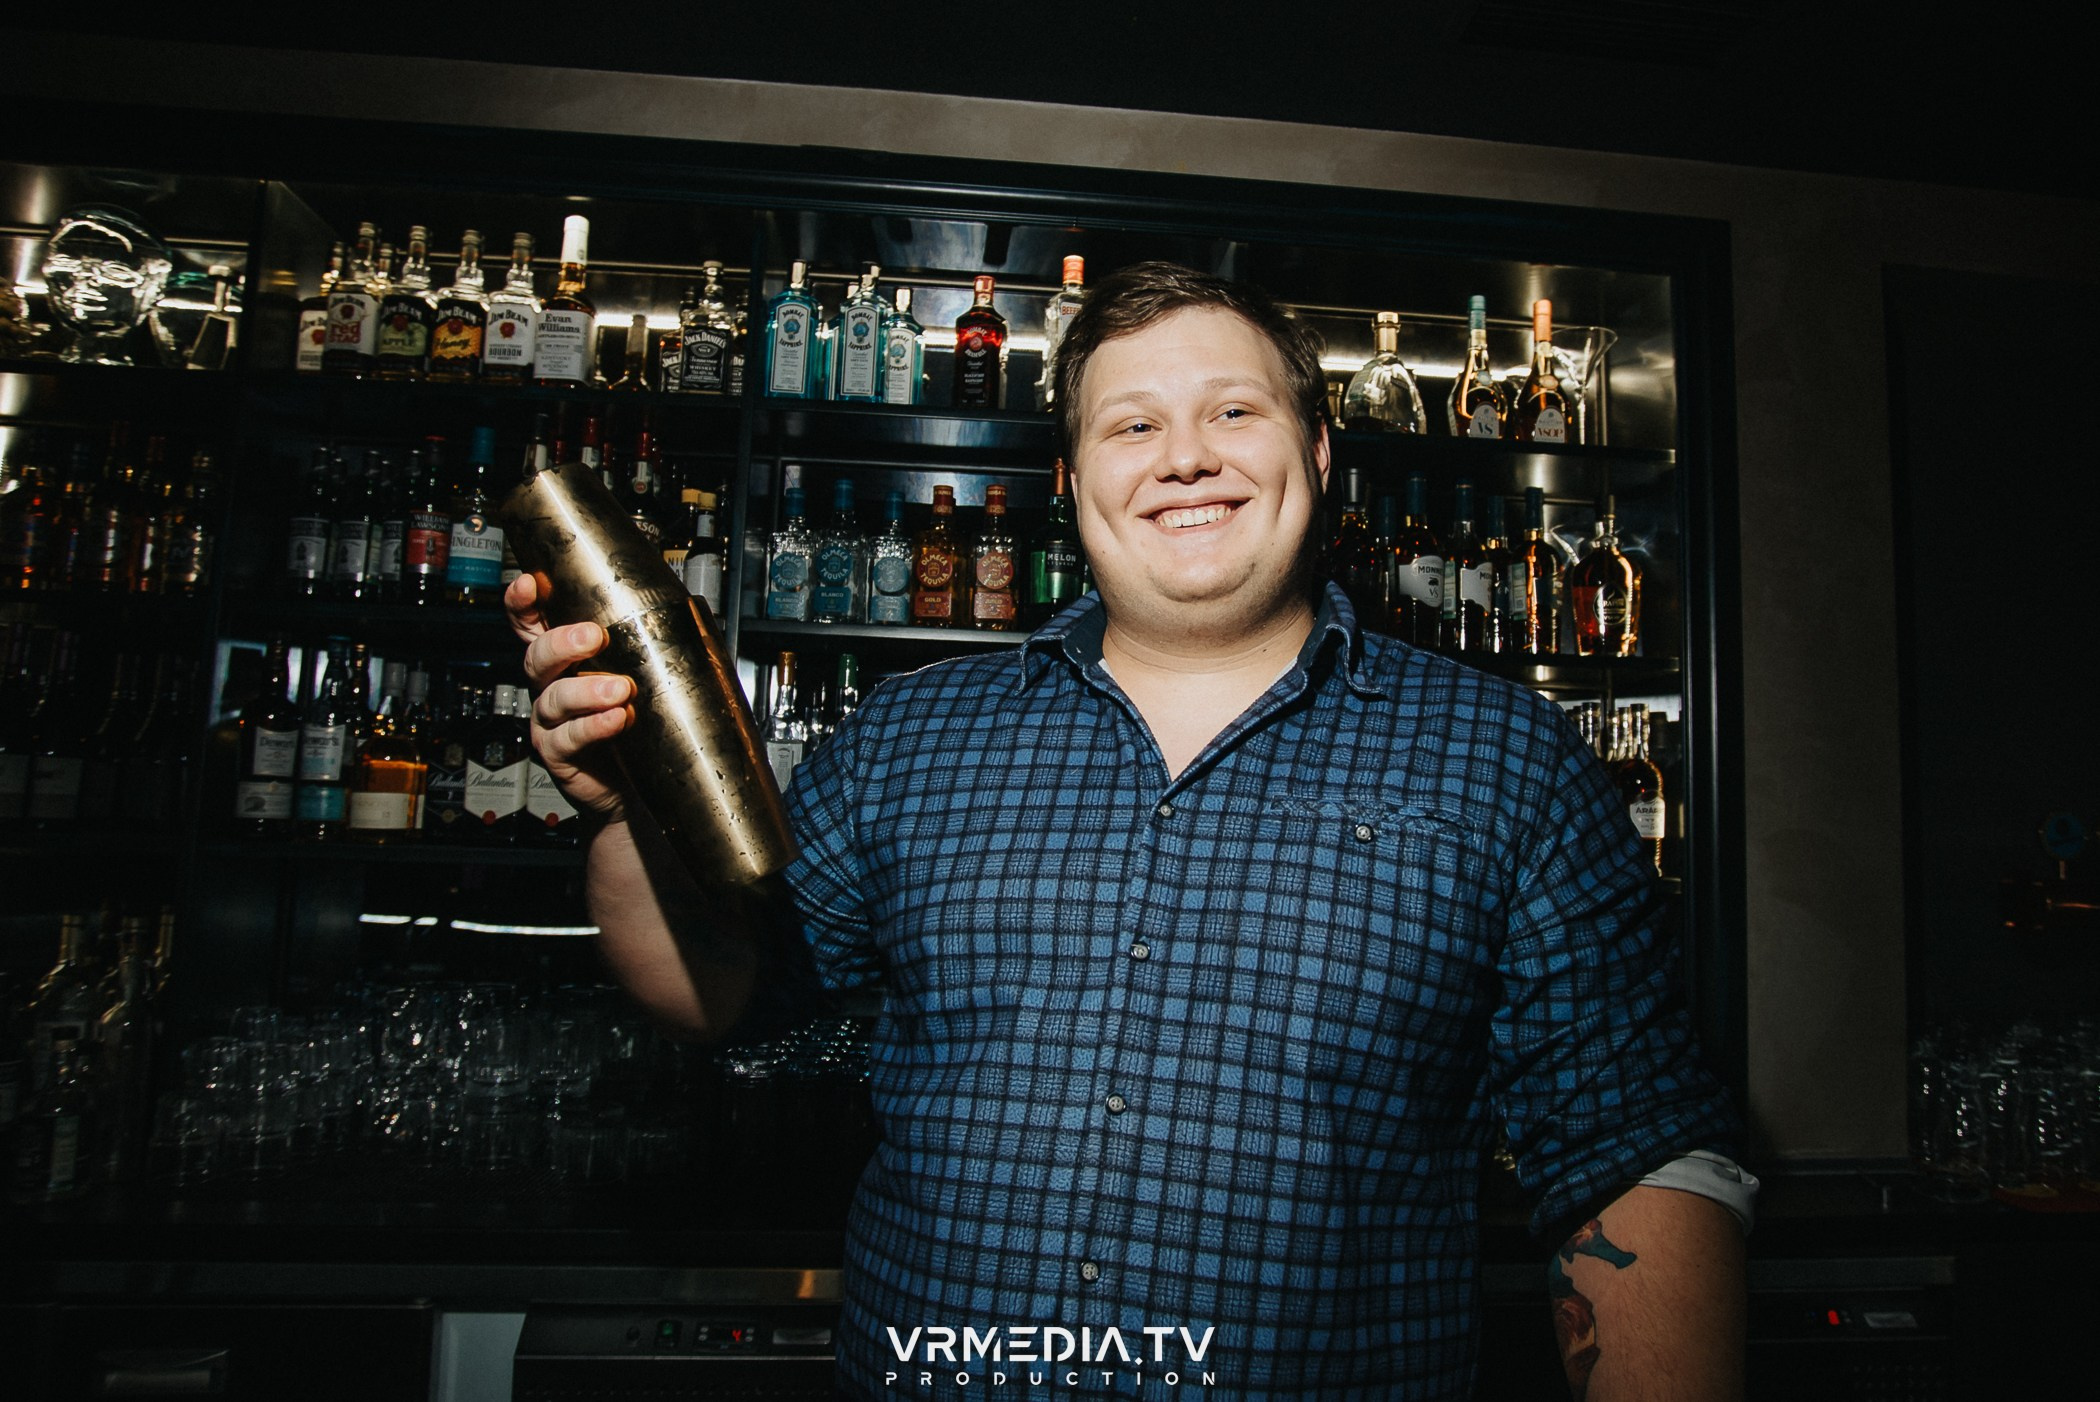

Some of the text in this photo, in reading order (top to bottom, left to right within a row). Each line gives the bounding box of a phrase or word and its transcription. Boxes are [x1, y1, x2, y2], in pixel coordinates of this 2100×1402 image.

[489, 309, 529, 327] JIM BEAM
[545, 313, 572, 323] Evan
[782, 309, 804, 319] BOMBAY
[537, 323, 581, 333] Williams
[684, 334, 702, 346] JACK
[1478, 422, 1493, 435] VS
[450, 536, 502, 552] INGLETON
[821, 549, 848, 561] OLMECA
[921, 554, 948, 566] OLMECA
[1047, 553, 1077, 562] MELON
[821, 567, 849, 580] TEQUILA
[920, 572, 949, 585] TEQUILA
